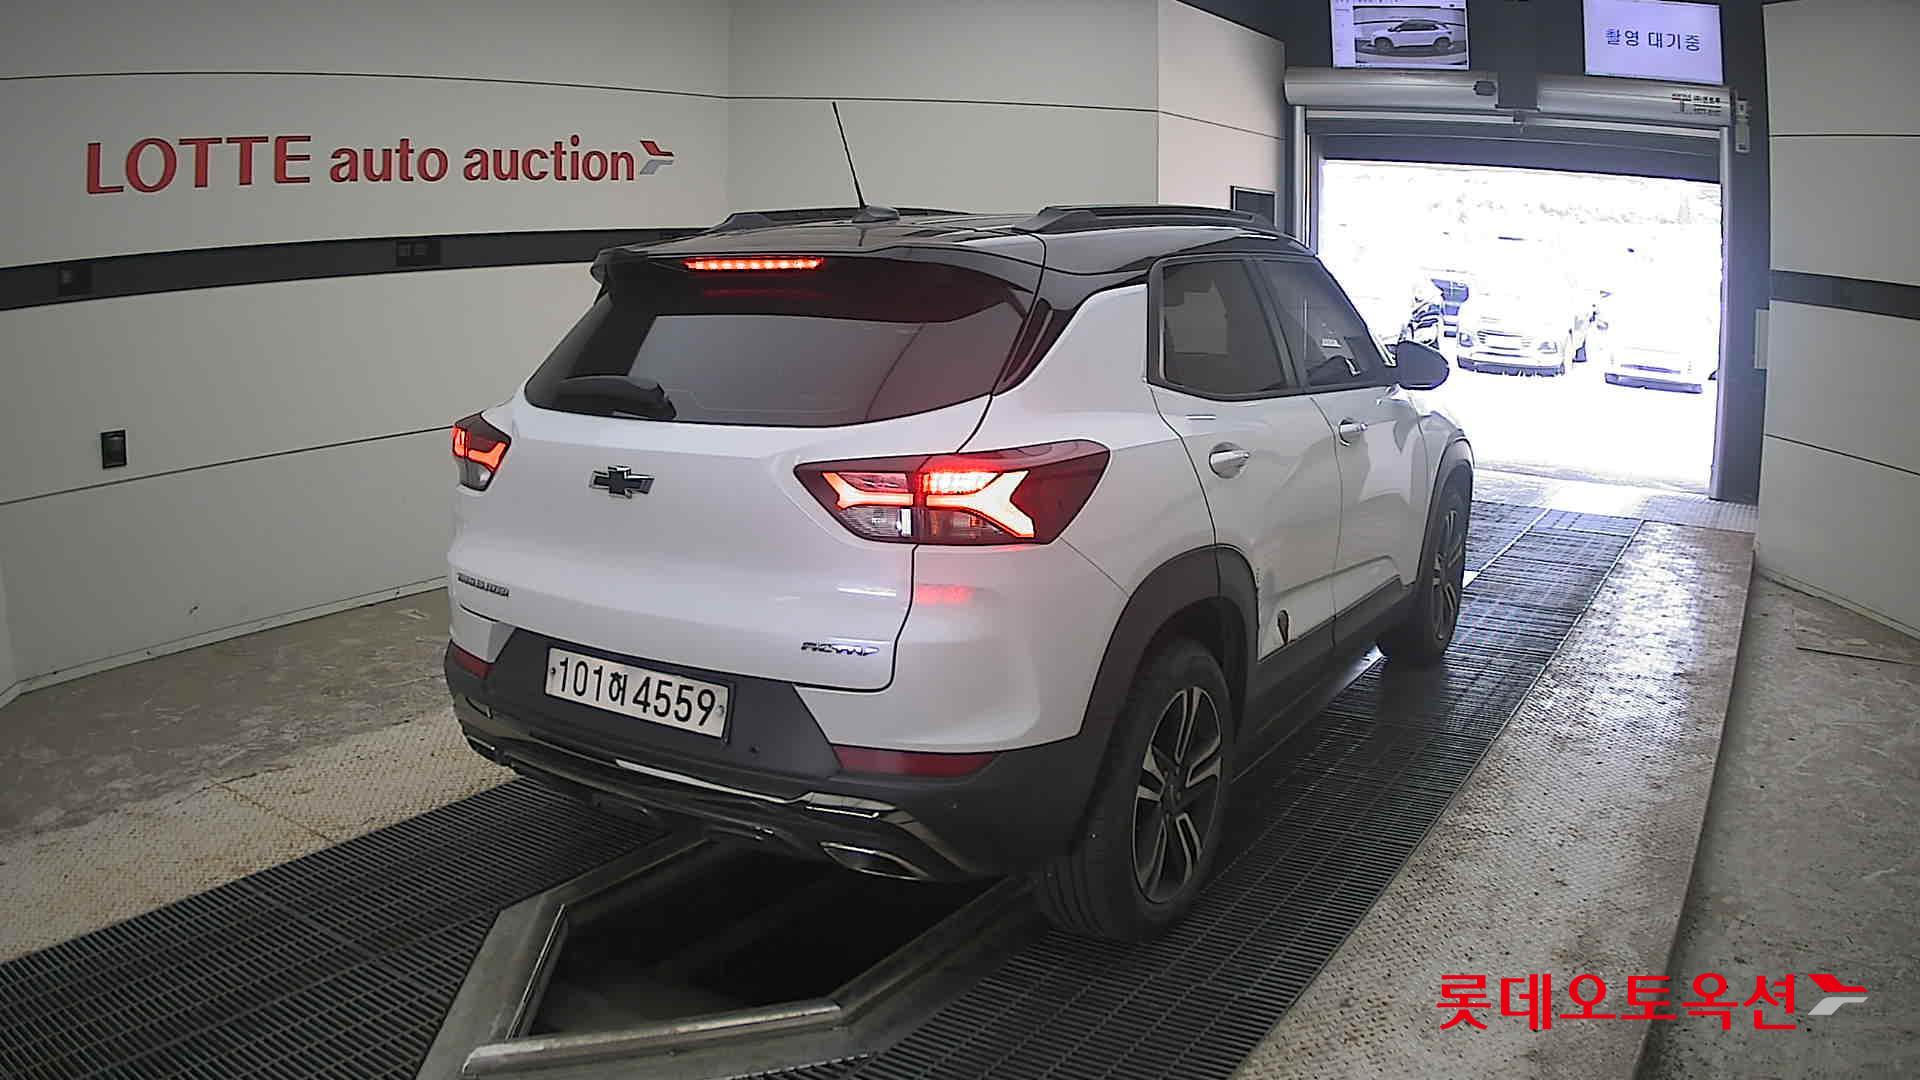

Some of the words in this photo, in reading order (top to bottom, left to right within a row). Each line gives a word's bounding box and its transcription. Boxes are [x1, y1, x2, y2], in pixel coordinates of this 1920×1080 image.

[1605, 28, 1639, 47] 촬영
[1647, 31, 1701, 52] 대기중
[86, 135, 312, 195] LOTTE
[329, 137, 449, 183] auto
[463, 133, 635, 182] auction
